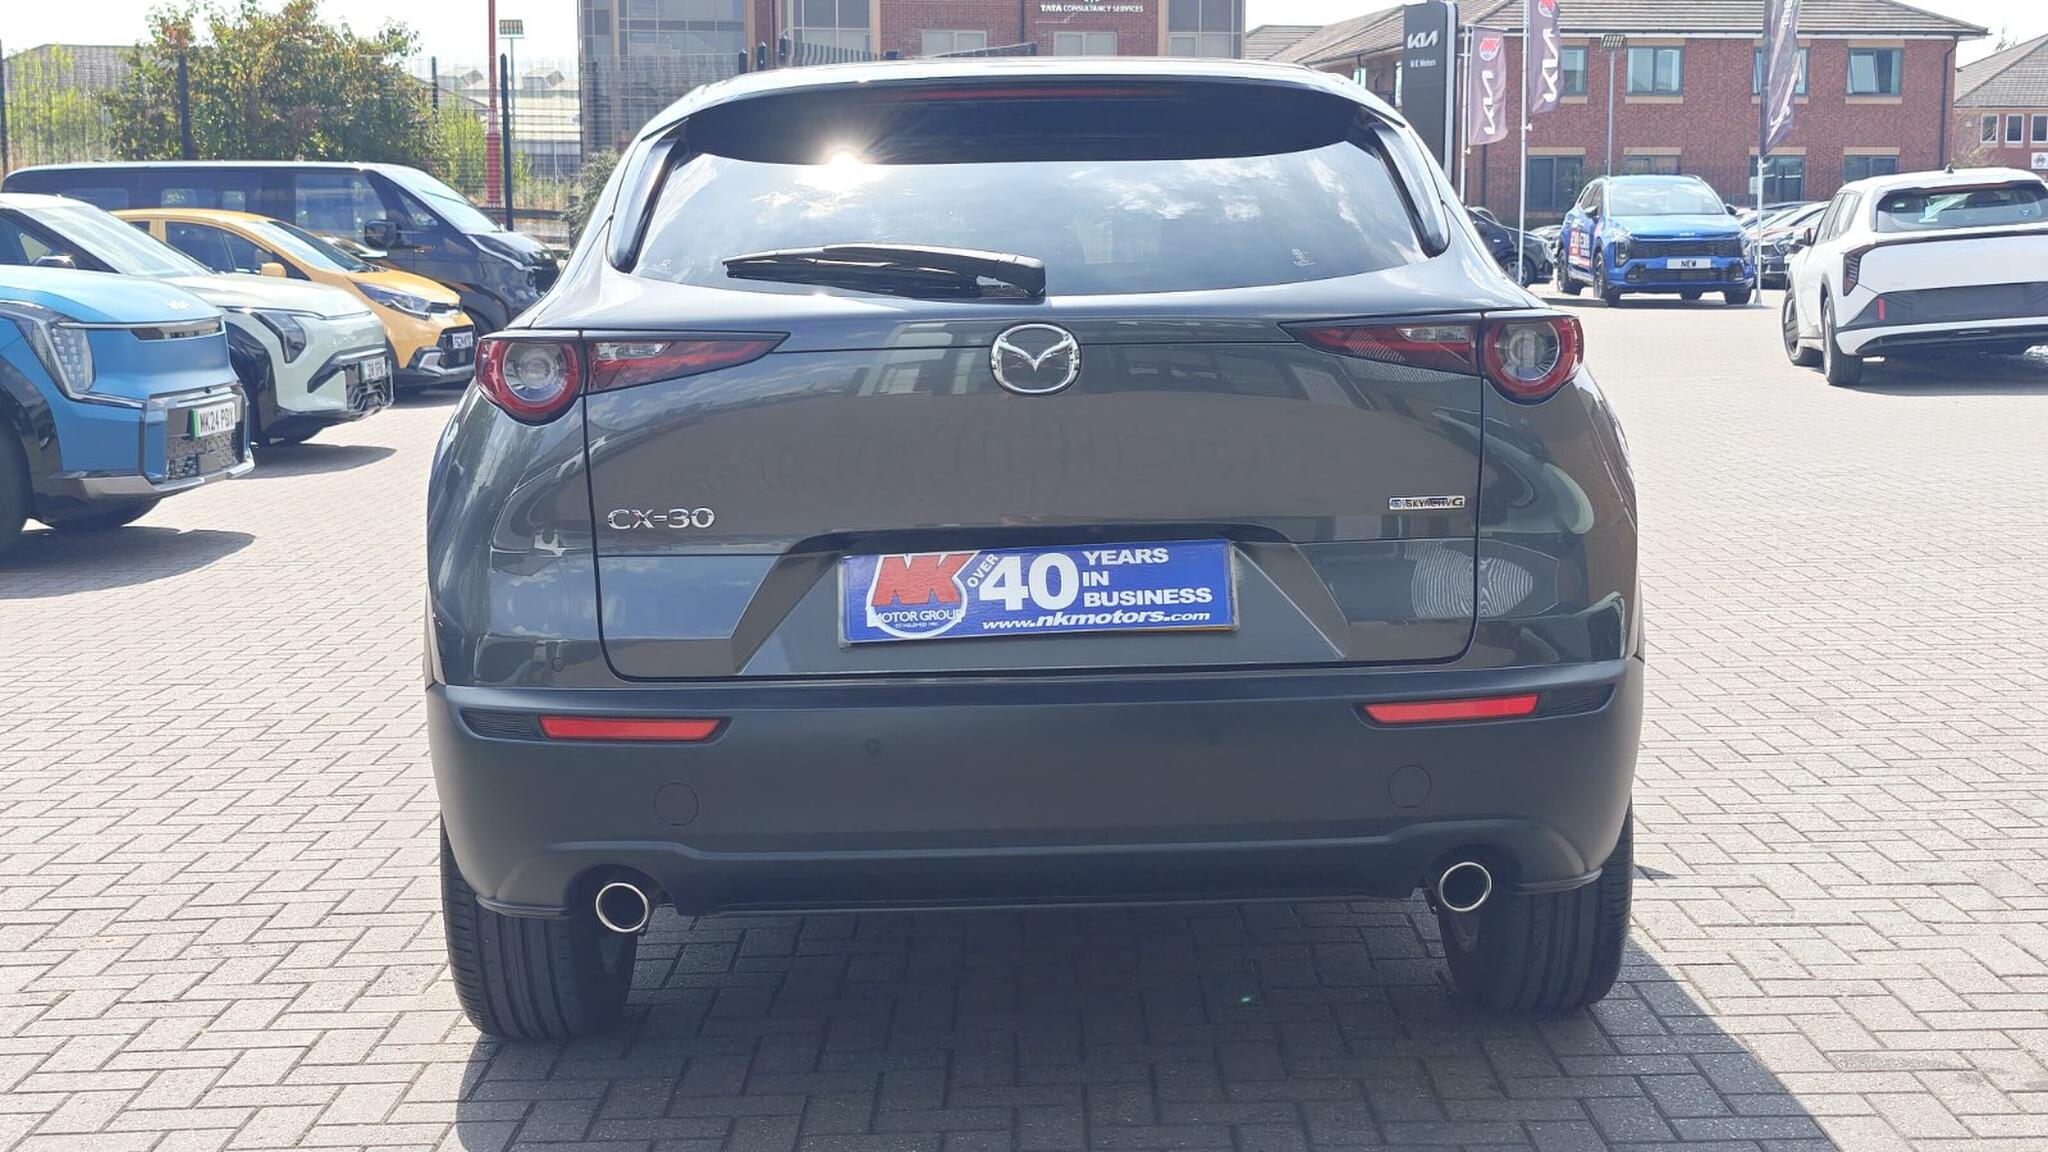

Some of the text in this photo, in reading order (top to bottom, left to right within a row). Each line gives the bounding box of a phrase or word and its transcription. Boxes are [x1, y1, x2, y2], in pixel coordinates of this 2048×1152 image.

[1040, 4, 1144, 12] TATA CONSULTANCY SERVICES
[1407, 30, 1438, 49] KIA
[607, 507, 715, 529] CX-30
[1082, 548, 1169, 565] YEARS
[967, 553, 999, 588] OVER
[1082, 571, 1109, 586] IN
[979, 552, 1079, 611] 40
[1084, 588, 1213, 607] BUSINESS
[982, 610, 1210, 630] www.nkmotors.com
